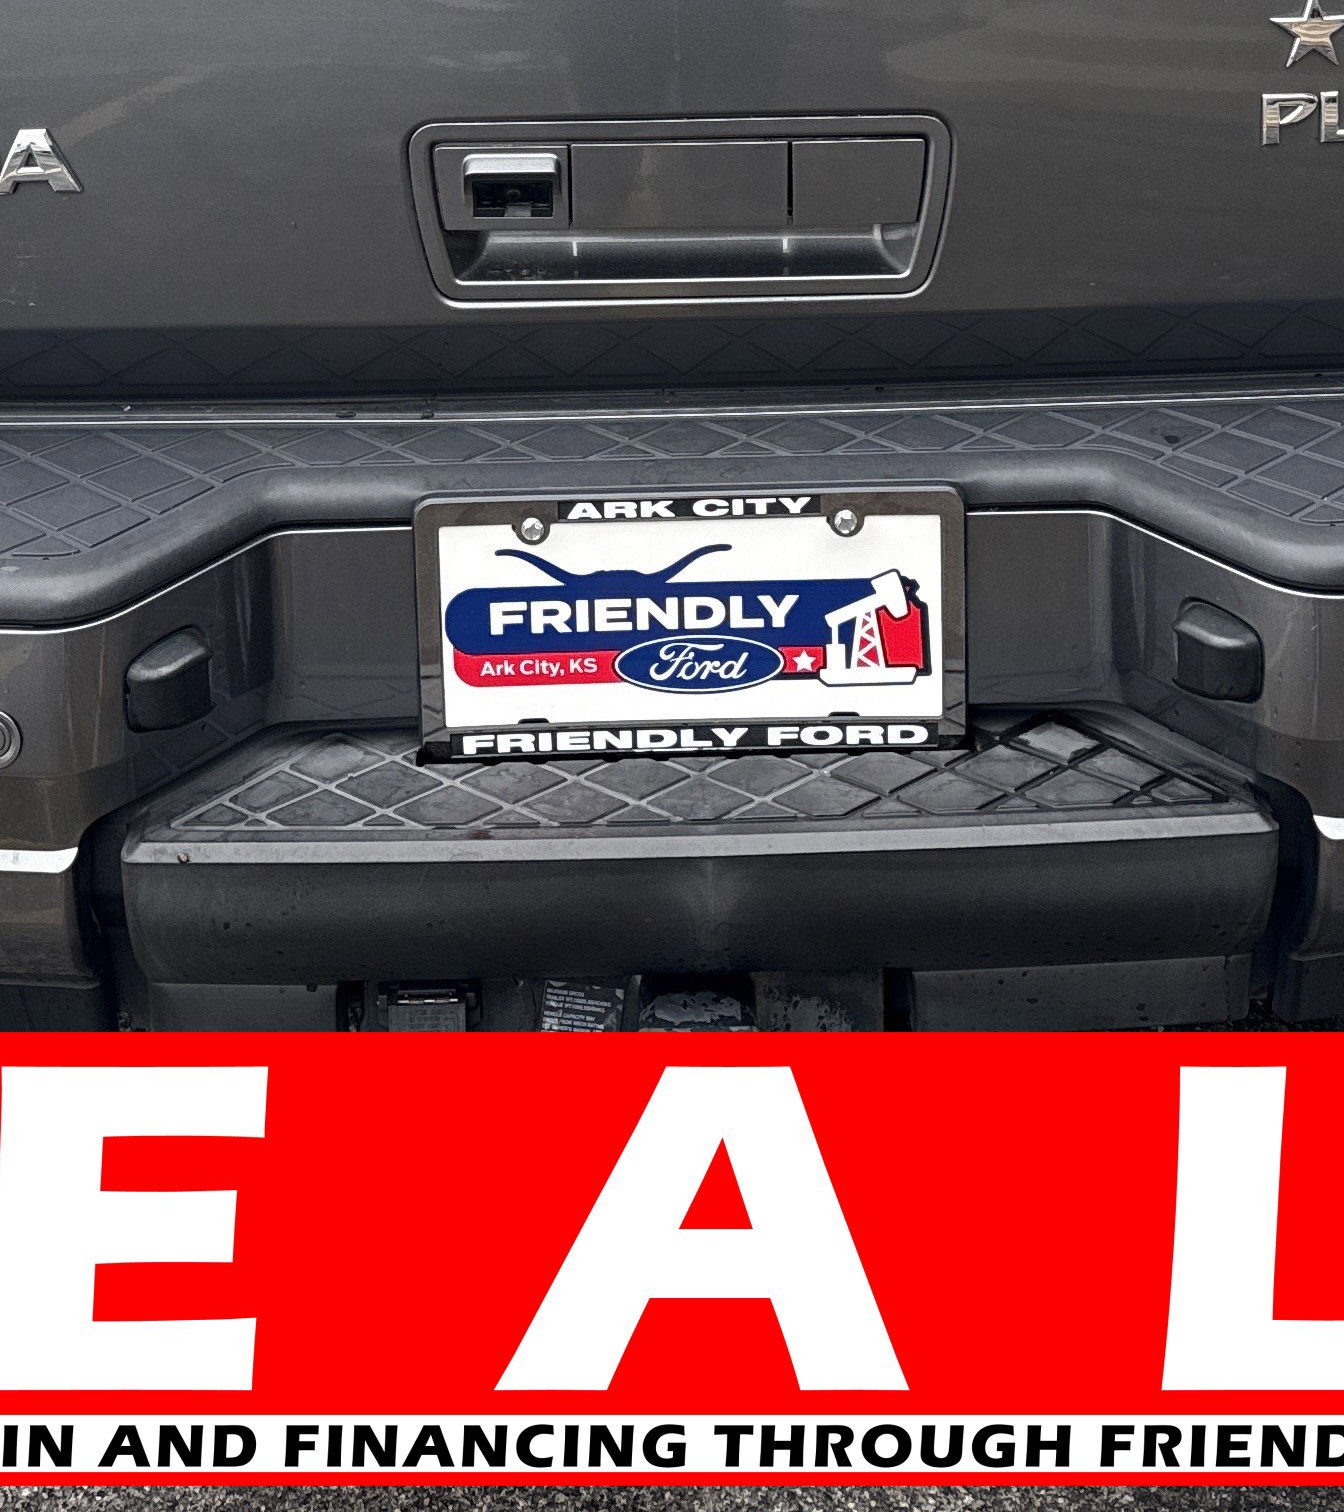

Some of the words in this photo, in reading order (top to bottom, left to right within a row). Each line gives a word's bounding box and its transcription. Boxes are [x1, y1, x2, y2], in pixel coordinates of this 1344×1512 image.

[567, 500, 676, 520] ARK
[692, 496, 812, 517] CITY
[489, 594, 800, 636] FRIENDLY
[480, 659, 516, 677] Ark
[519, 658, 565, 678] City,
[568, 657, 599, 675] KS
[649, 642, 749, 681] Ford
[462, 727, 749, 755] FRIENDLY
[767, 724, 929, 746] FORD
